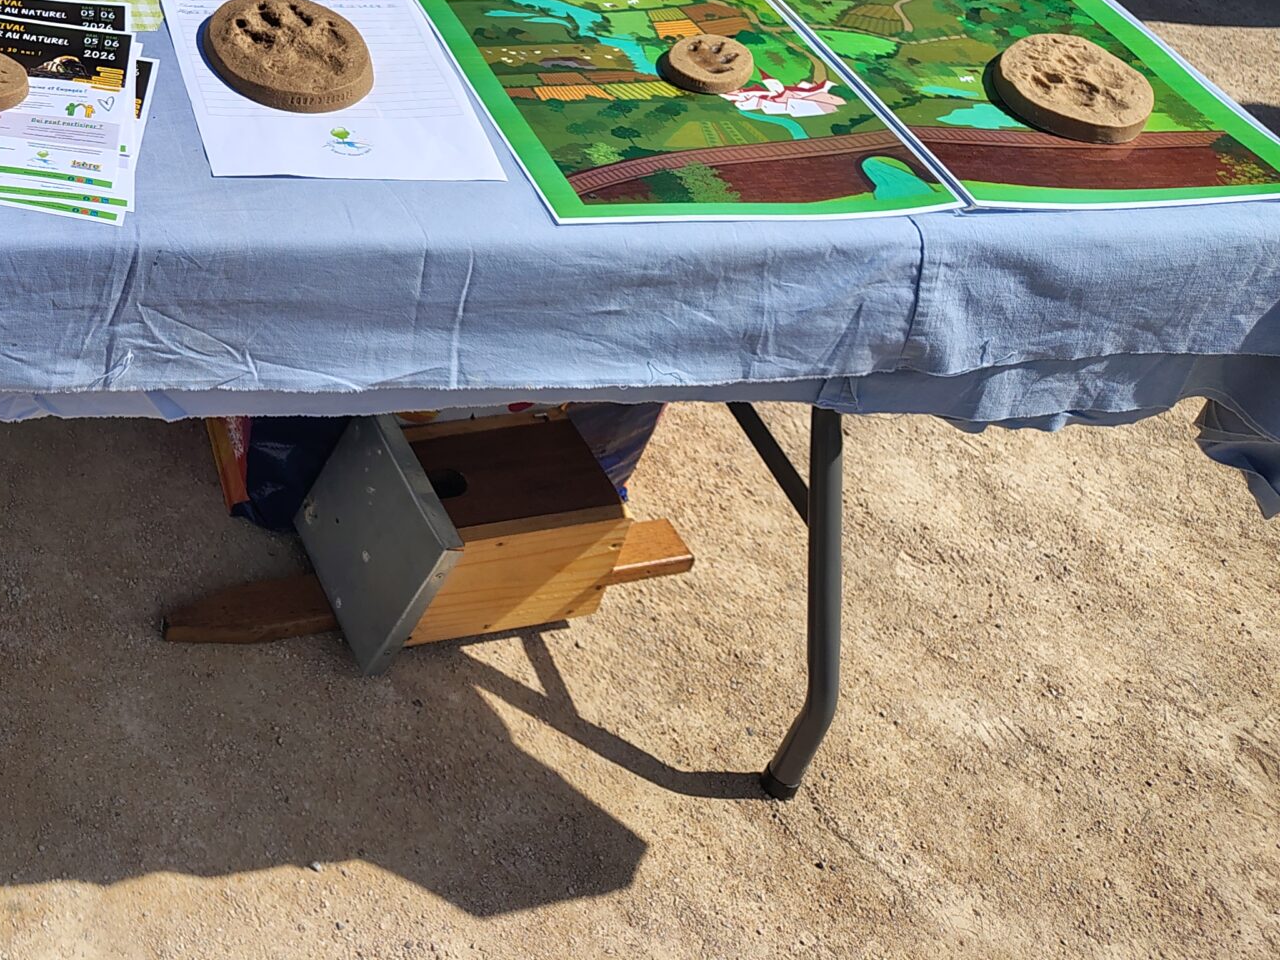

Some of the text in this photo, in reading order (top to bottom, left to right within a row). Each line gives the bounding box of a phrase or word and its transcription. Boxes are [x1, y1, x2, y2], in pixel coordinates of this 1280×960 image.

[4, 7, 19, 15] AU
[21, 8, 67, 20] NATUREL
[100, 11, 116, 20] 06
[82, 21, 114, 30] 2026
[5, 31, 21, 40] AU
[22, 33, 70, 46] NATUREL
[83, 37, 120, 48] 05 06
[83, 49, 116, 61] 2026
[290, 96, 315, 105] LOUP
